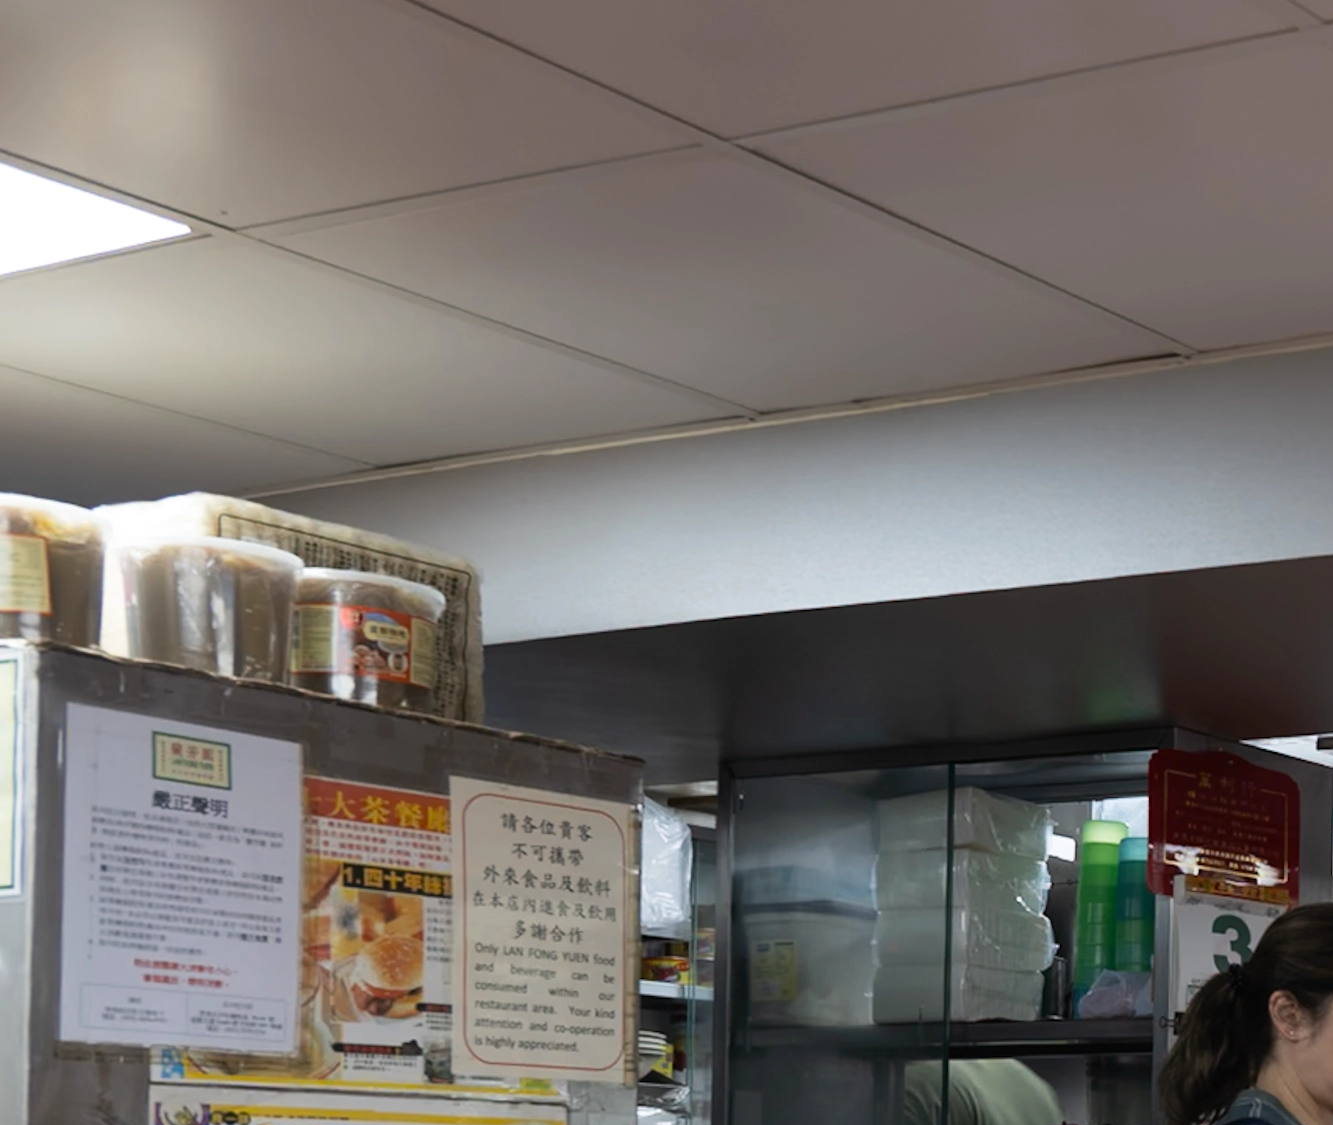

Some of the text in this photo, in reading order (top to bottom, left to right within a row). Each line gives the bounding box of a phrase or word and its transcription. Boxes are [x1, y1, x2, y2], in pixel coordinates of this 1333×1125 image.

[501, 812, 593, 842] 請各位貴客
[512, 843, 584, 867] 不可攜帶
[483, 865, 611, 898] 外來食品及飲料
[473, 890, 616, 922] 在本店內進食及飲用
[513, 920, 584, 944] 多謝合作
[475, 942, 615, 966] Only LAN FONG YUEN food
[475, 963, 615, 983] and beverage can be
[475, 981, 615, 1001] consumed within our
[475, 1000, 615, 1019] restaurant area. Your kind
[475, 1018, 615, 1036] attention and co-operation
[475, 1036, 579, 1051] is highly appreciated.
